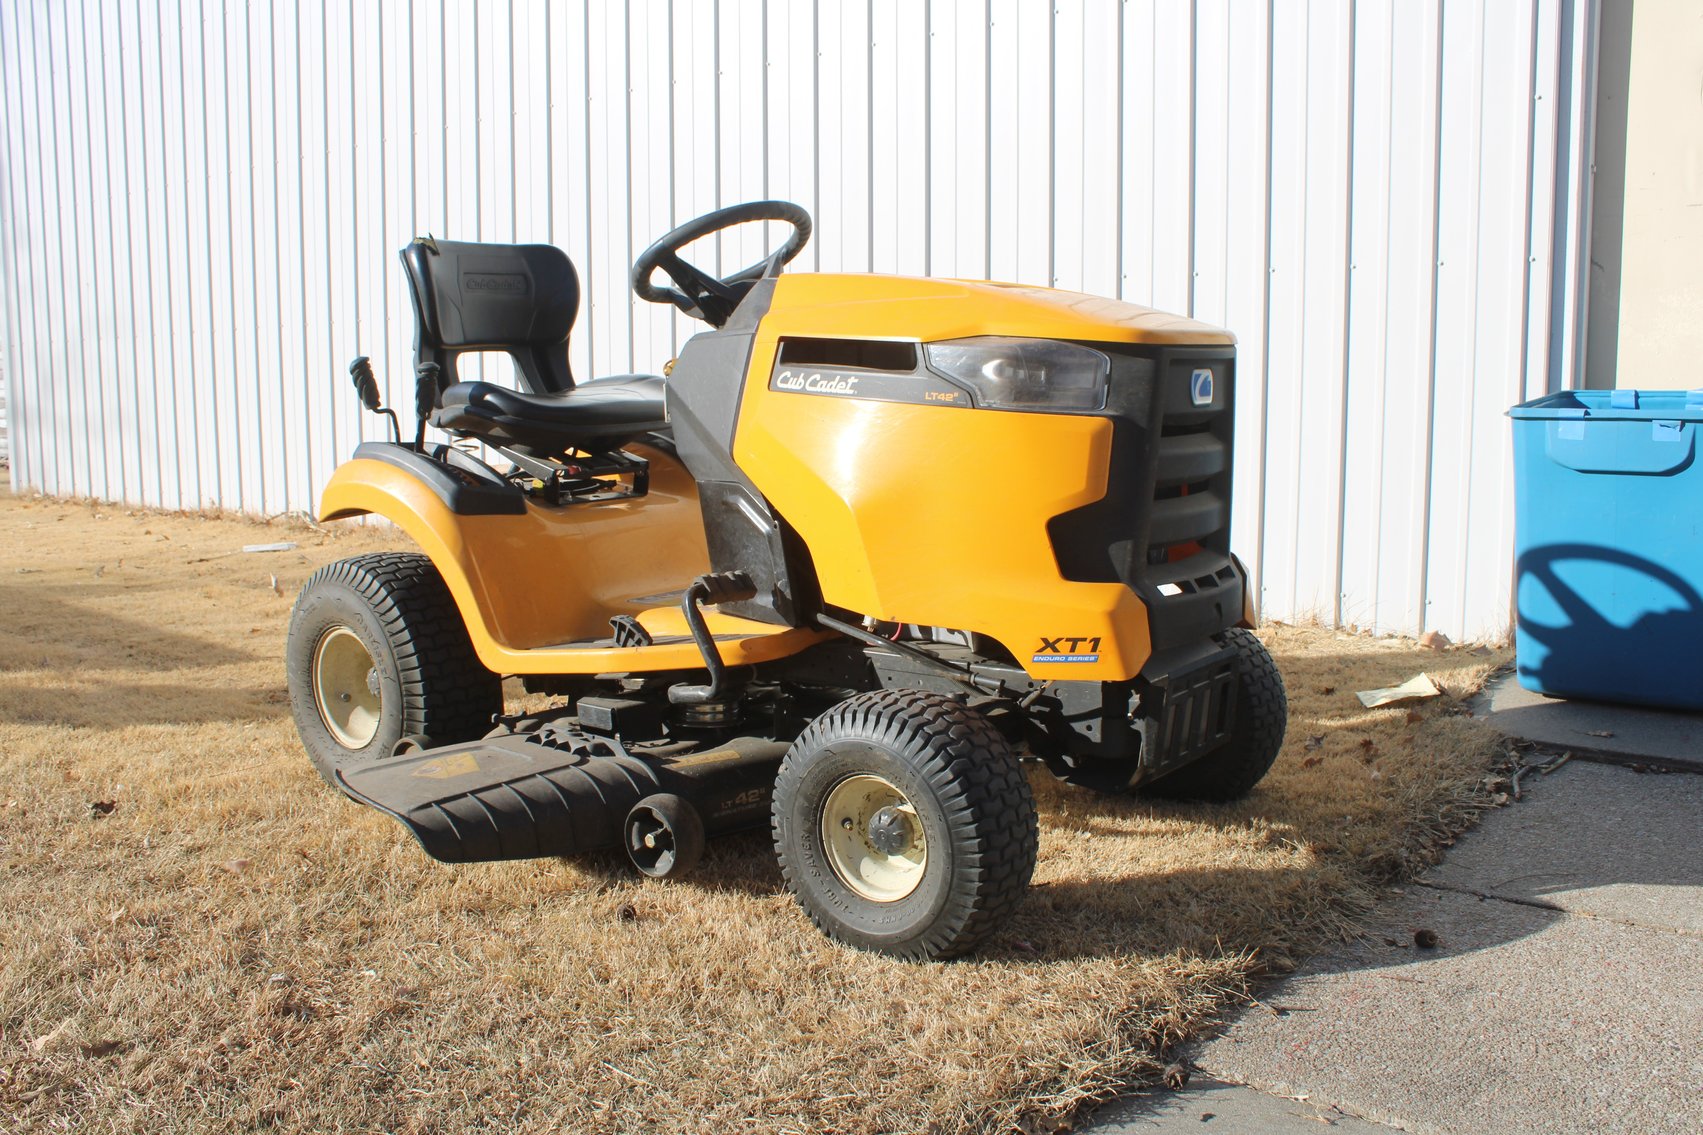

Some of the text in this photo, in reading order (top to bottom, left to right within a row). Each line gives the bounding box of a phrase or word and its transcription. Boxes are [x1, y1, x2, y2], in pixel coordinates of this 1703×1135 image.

[777, 370, 858, 394] Cub Cadet
[1035, 637, 1102, 653] XT1
